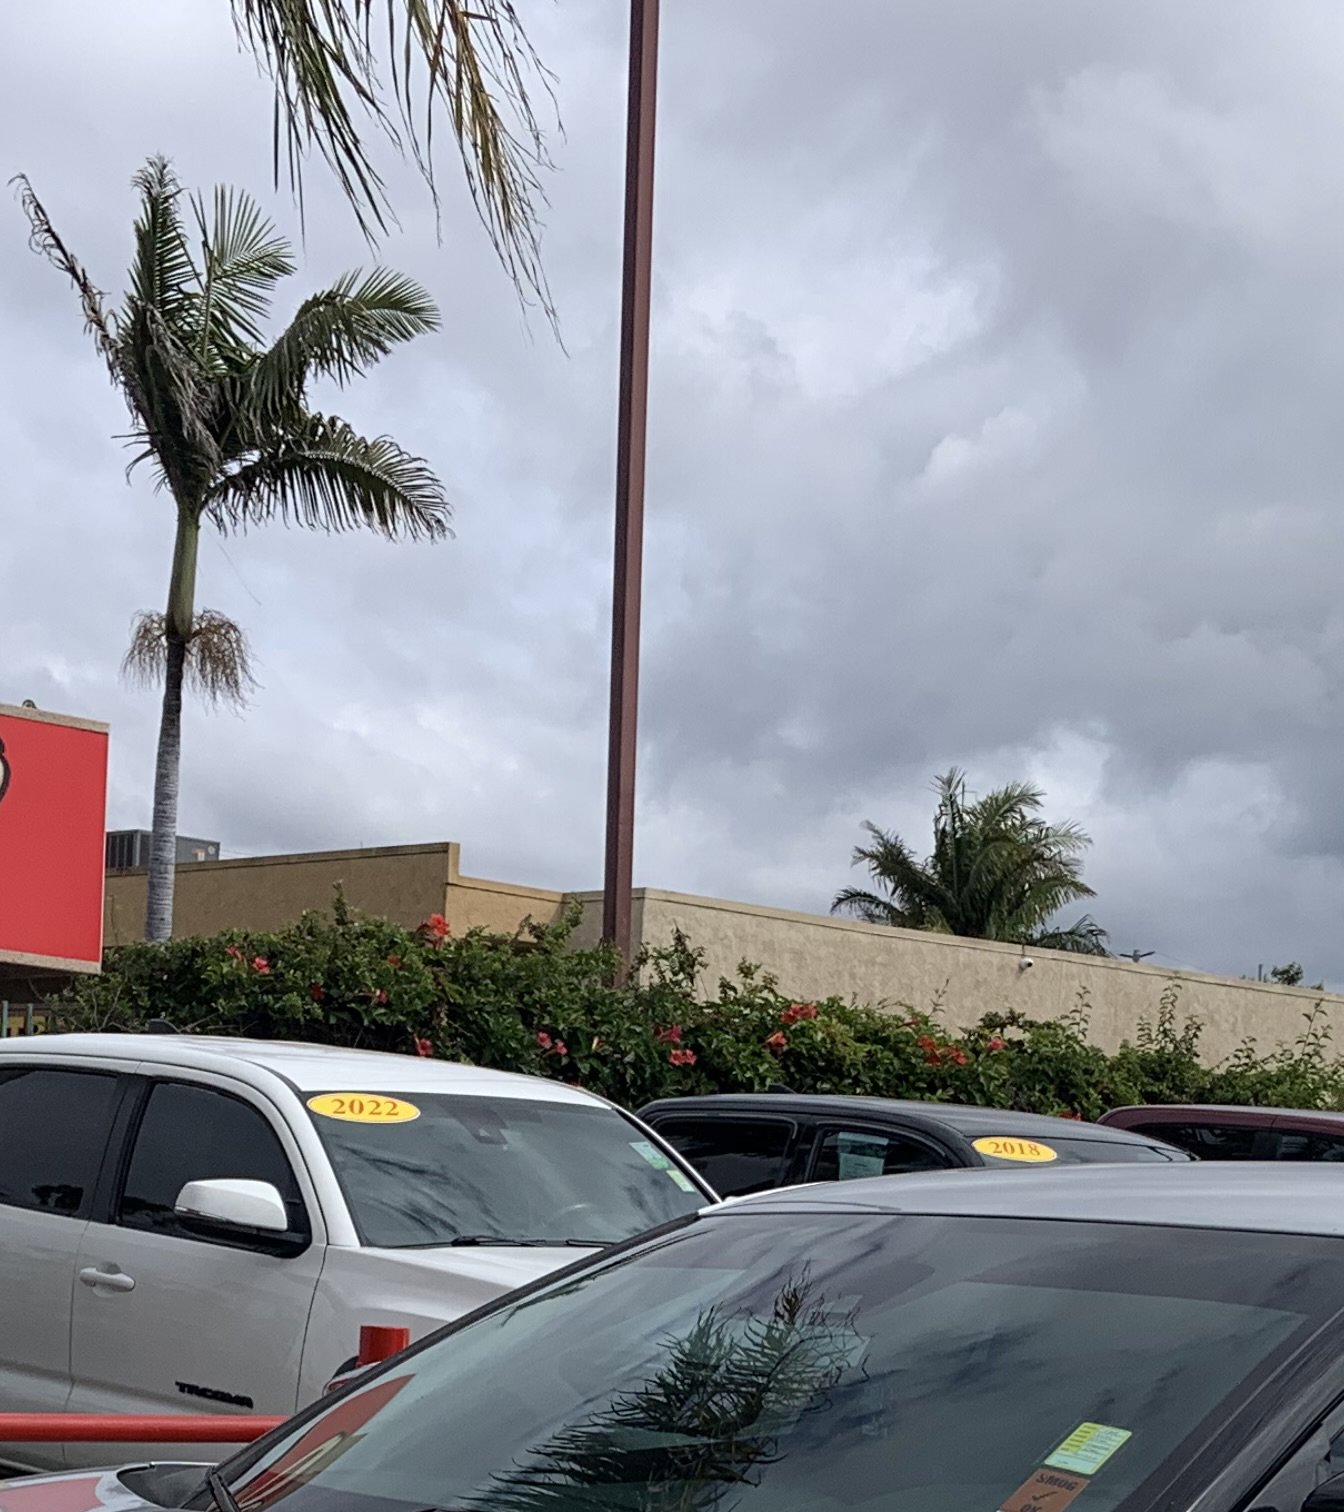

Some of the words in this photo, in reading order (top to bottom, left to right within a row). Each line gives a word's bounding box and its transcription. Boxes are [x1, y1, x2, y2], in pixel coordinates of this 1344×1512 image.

[331, 1098, 399, 1116] 2022
[991, 1141, 1041, 1157] 2018
[1035, 1473, 1078, 1491] SMOG
